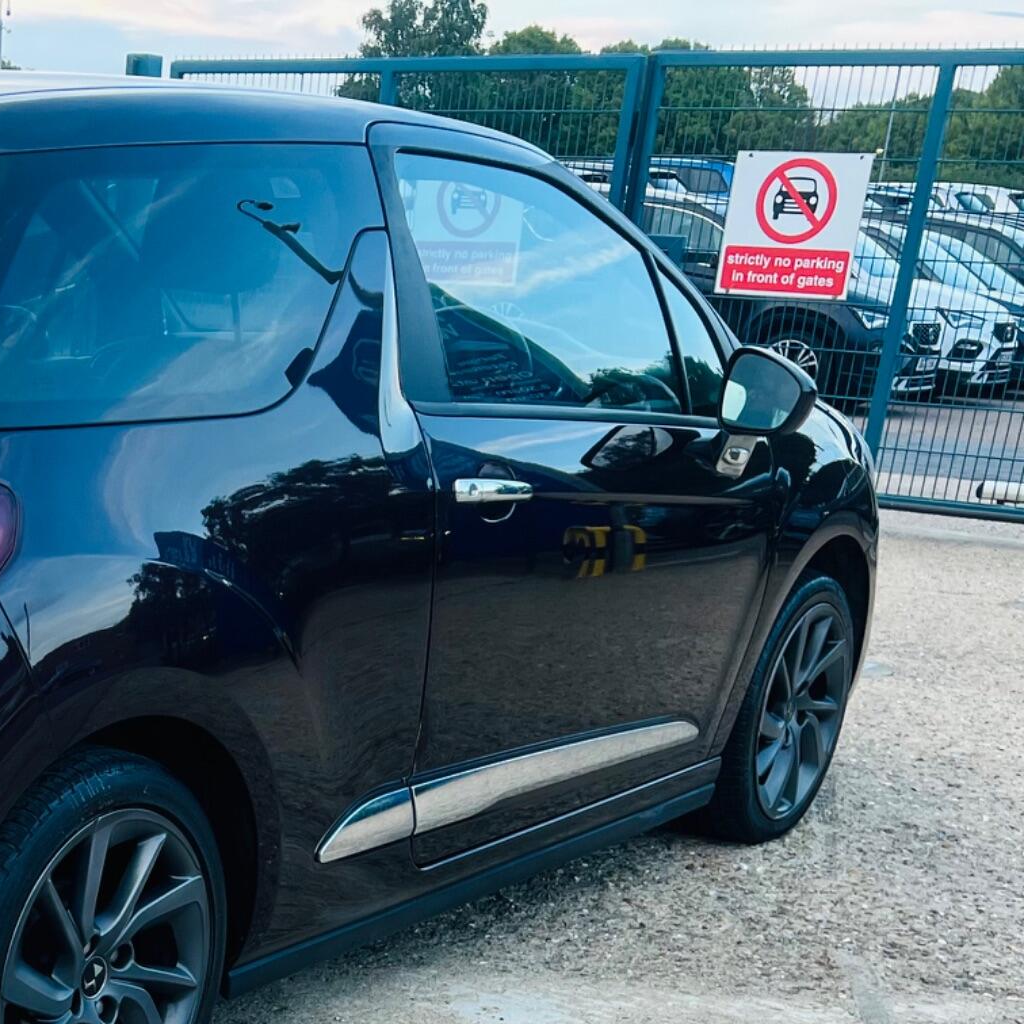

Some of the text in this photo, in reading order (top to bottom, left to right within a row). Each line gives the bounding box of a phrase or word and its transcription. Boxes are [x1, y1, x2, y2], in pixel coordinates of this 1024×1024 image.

[418, 247, 451, 261] trictly
[726, 253, 845, 273] strictly no parking
[732, 269, 834, 288] in front of gates
